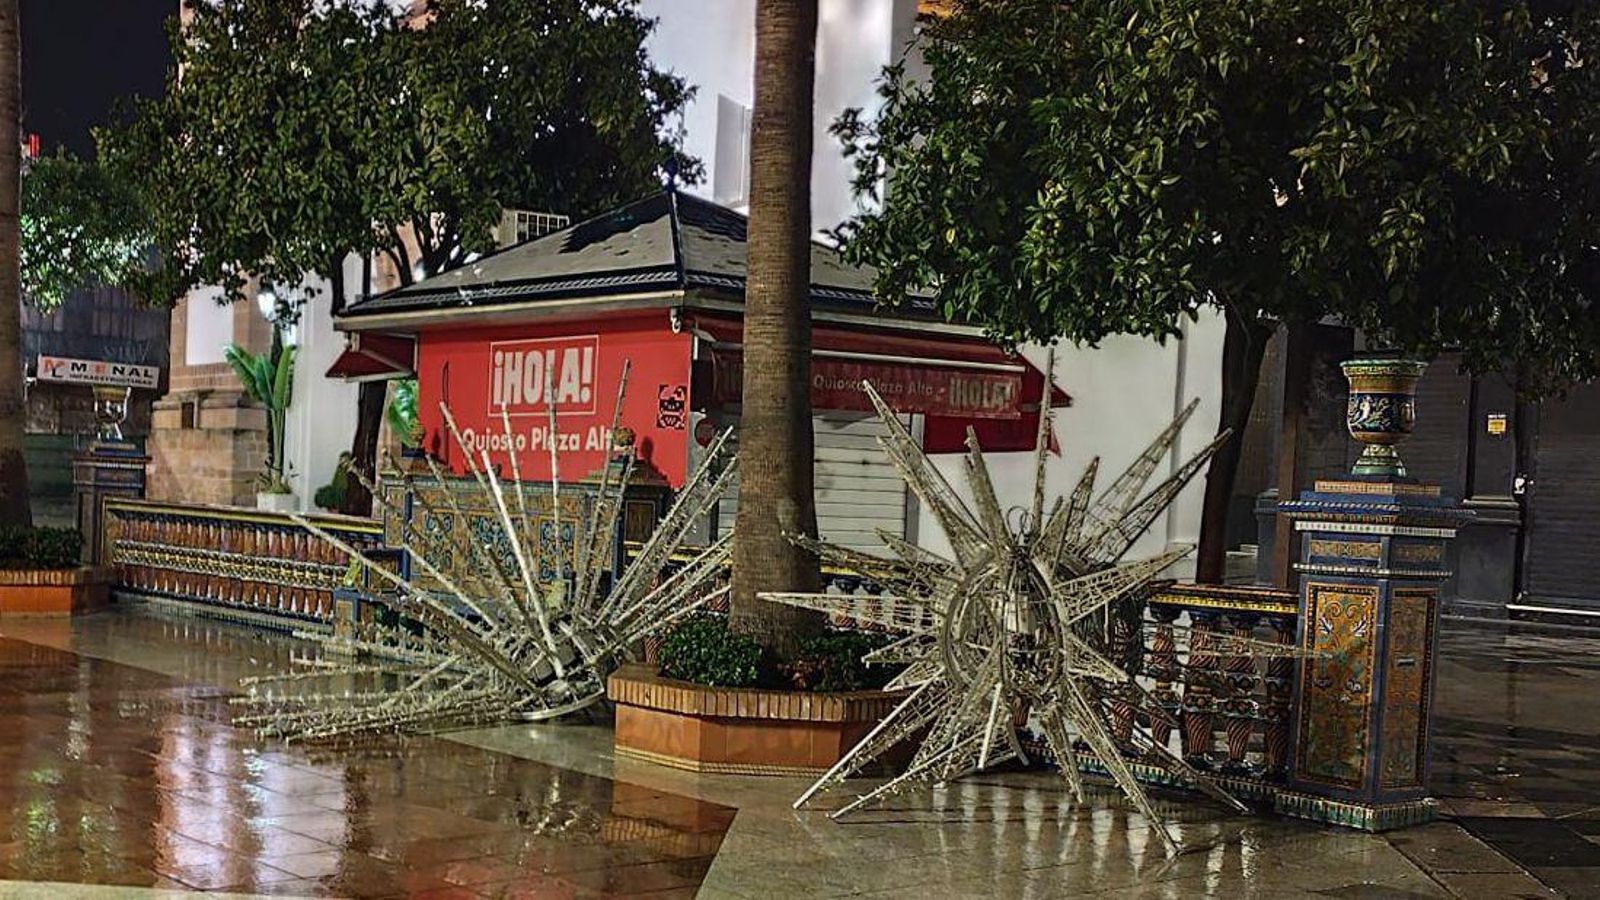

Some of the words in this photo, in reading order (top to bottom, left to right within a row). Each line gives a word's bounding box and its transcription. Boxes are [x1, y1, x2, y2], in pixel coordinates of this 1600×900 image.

[493, 346, 593, 405] ¡HOLA!
[462, 428, 526, 452] Quioso
[585, 426, 613, 451] Alt
